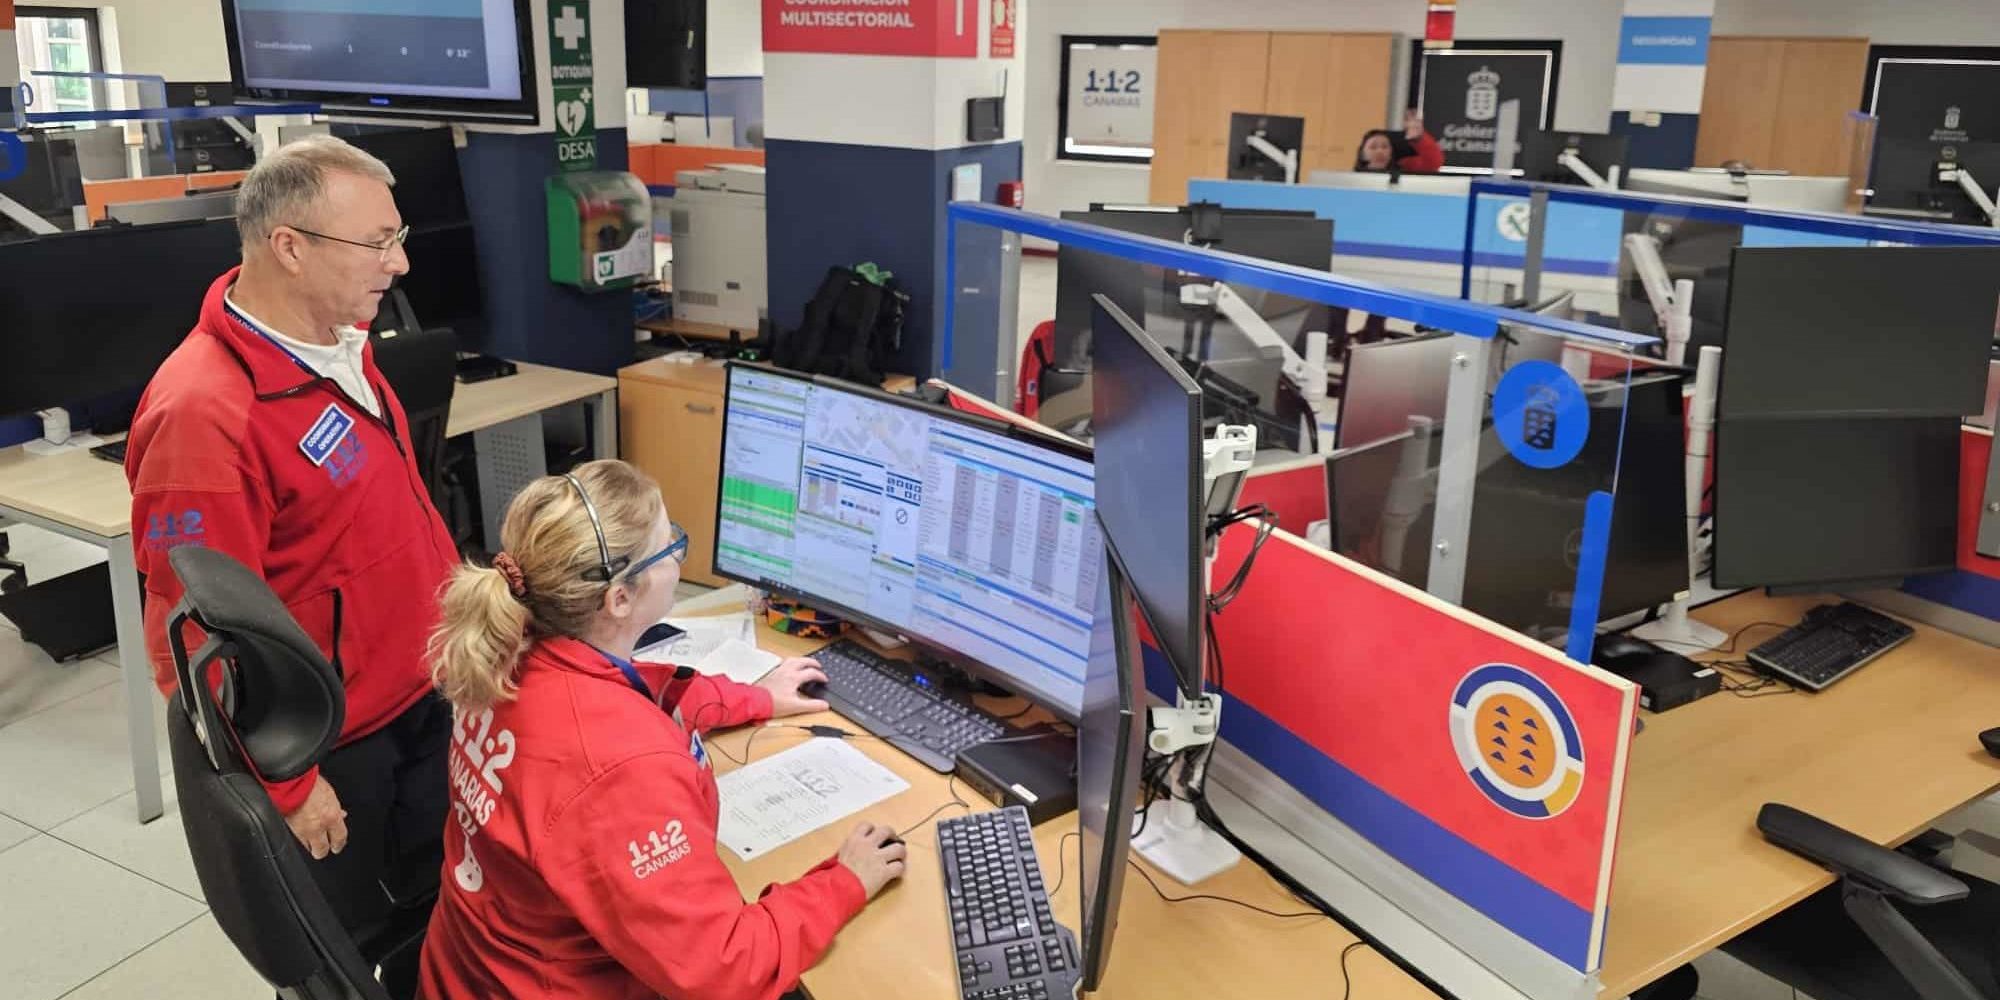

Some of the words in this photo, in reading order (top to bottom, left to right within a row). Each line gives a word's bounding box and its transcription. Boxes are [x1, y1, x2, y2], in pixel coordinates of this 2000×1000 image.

[780, 11, 914, 28] MULTISECTORIAL
[559, 141, 596, 161] DESA
[634, 842, 692, 879] CANARIAS
